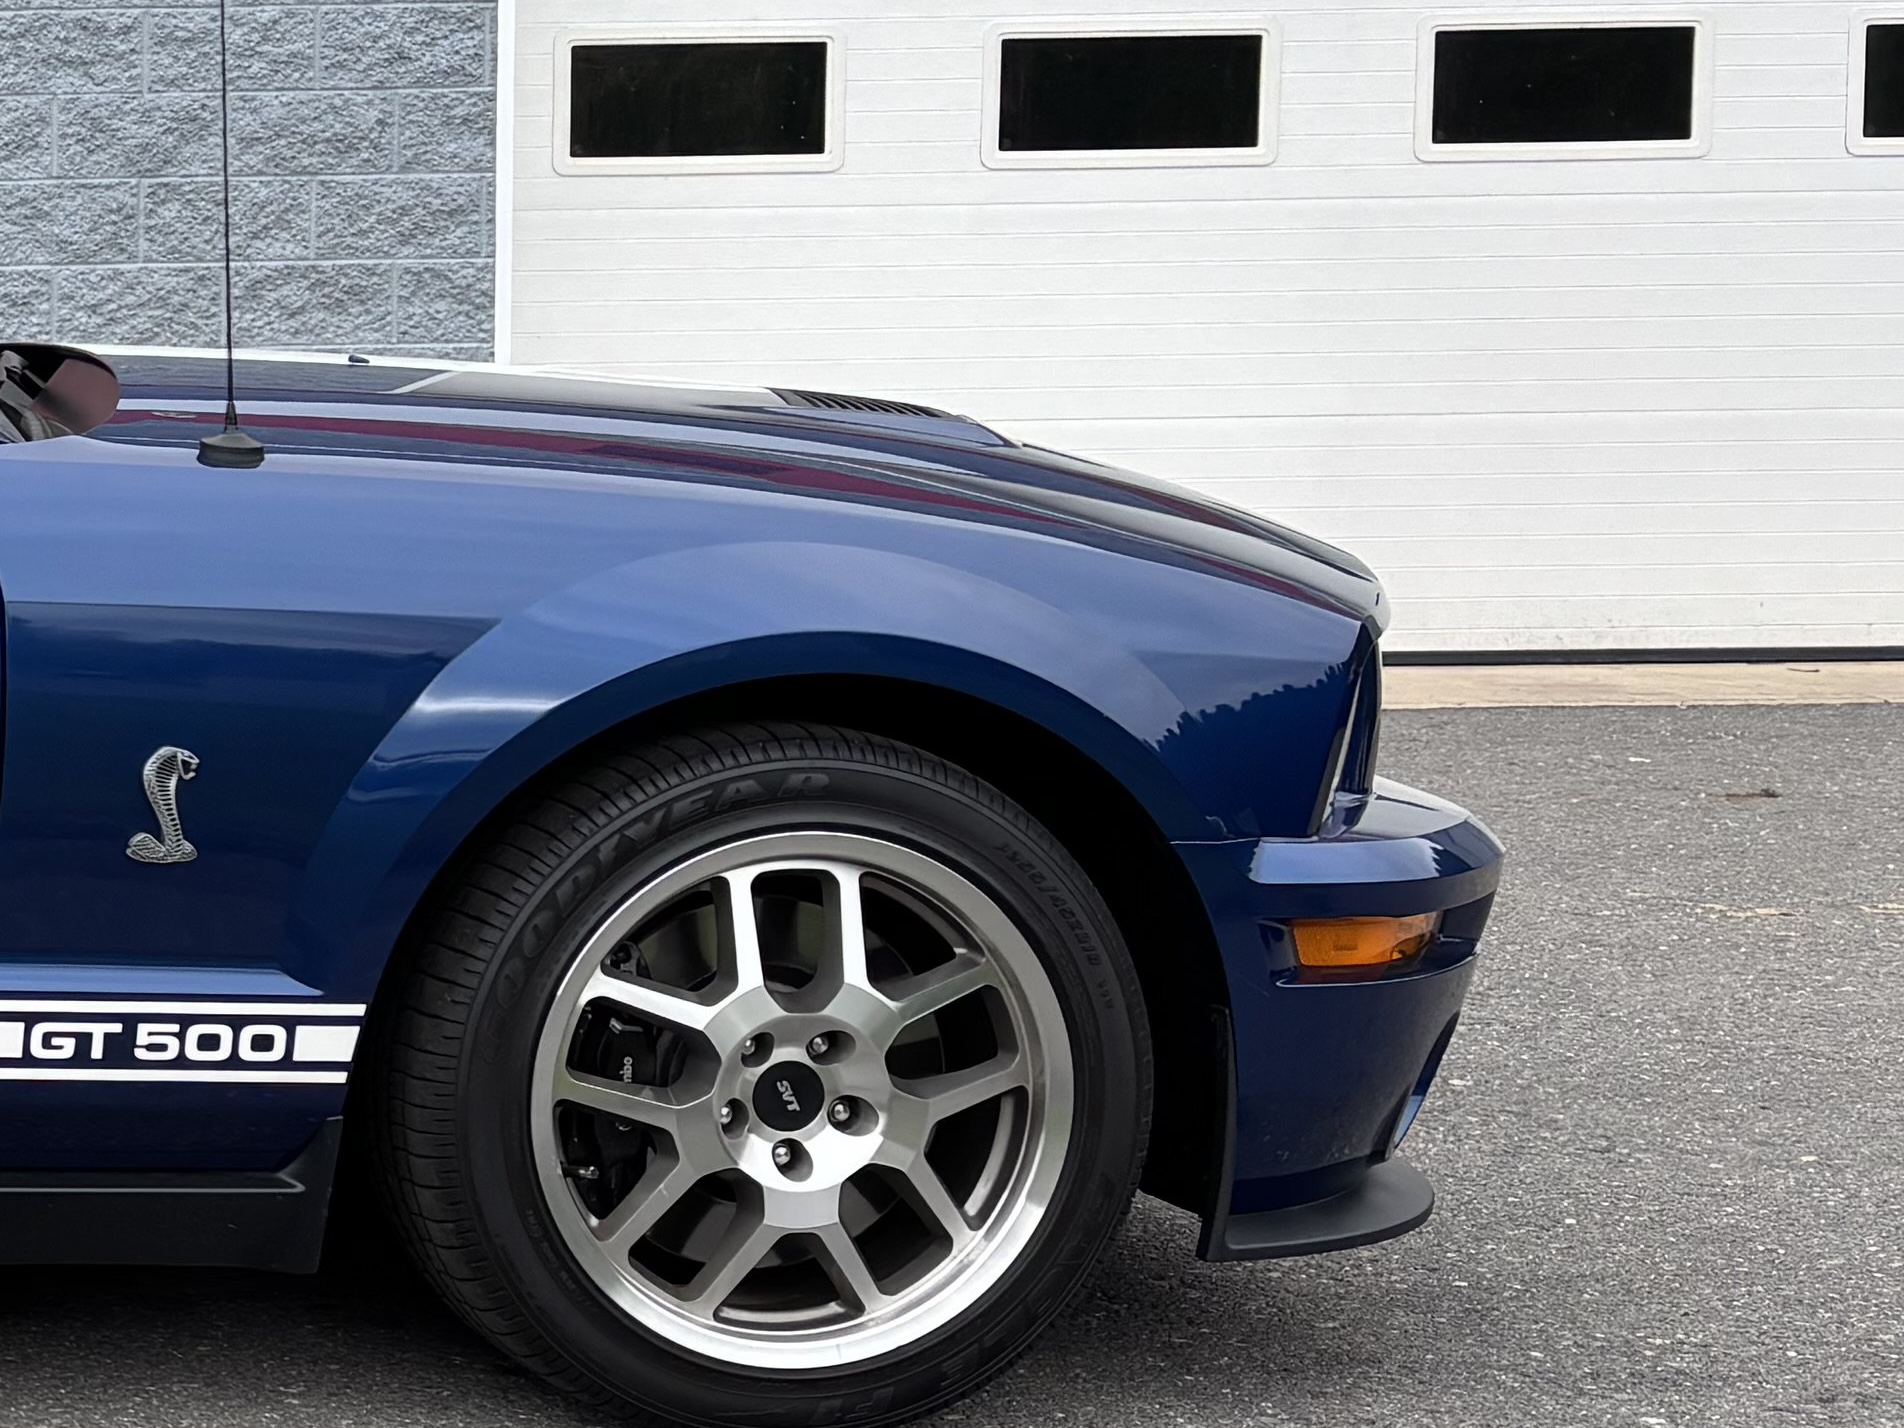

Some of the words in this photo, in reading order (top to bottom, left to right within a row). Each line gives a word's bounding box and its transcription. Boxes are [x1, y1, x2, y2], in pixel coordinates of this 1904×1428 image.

[29, 1022, 123, 1060] GT
[133, 1022, 288, 1062] 500
[776, 1080, 801, 1111] SVT
